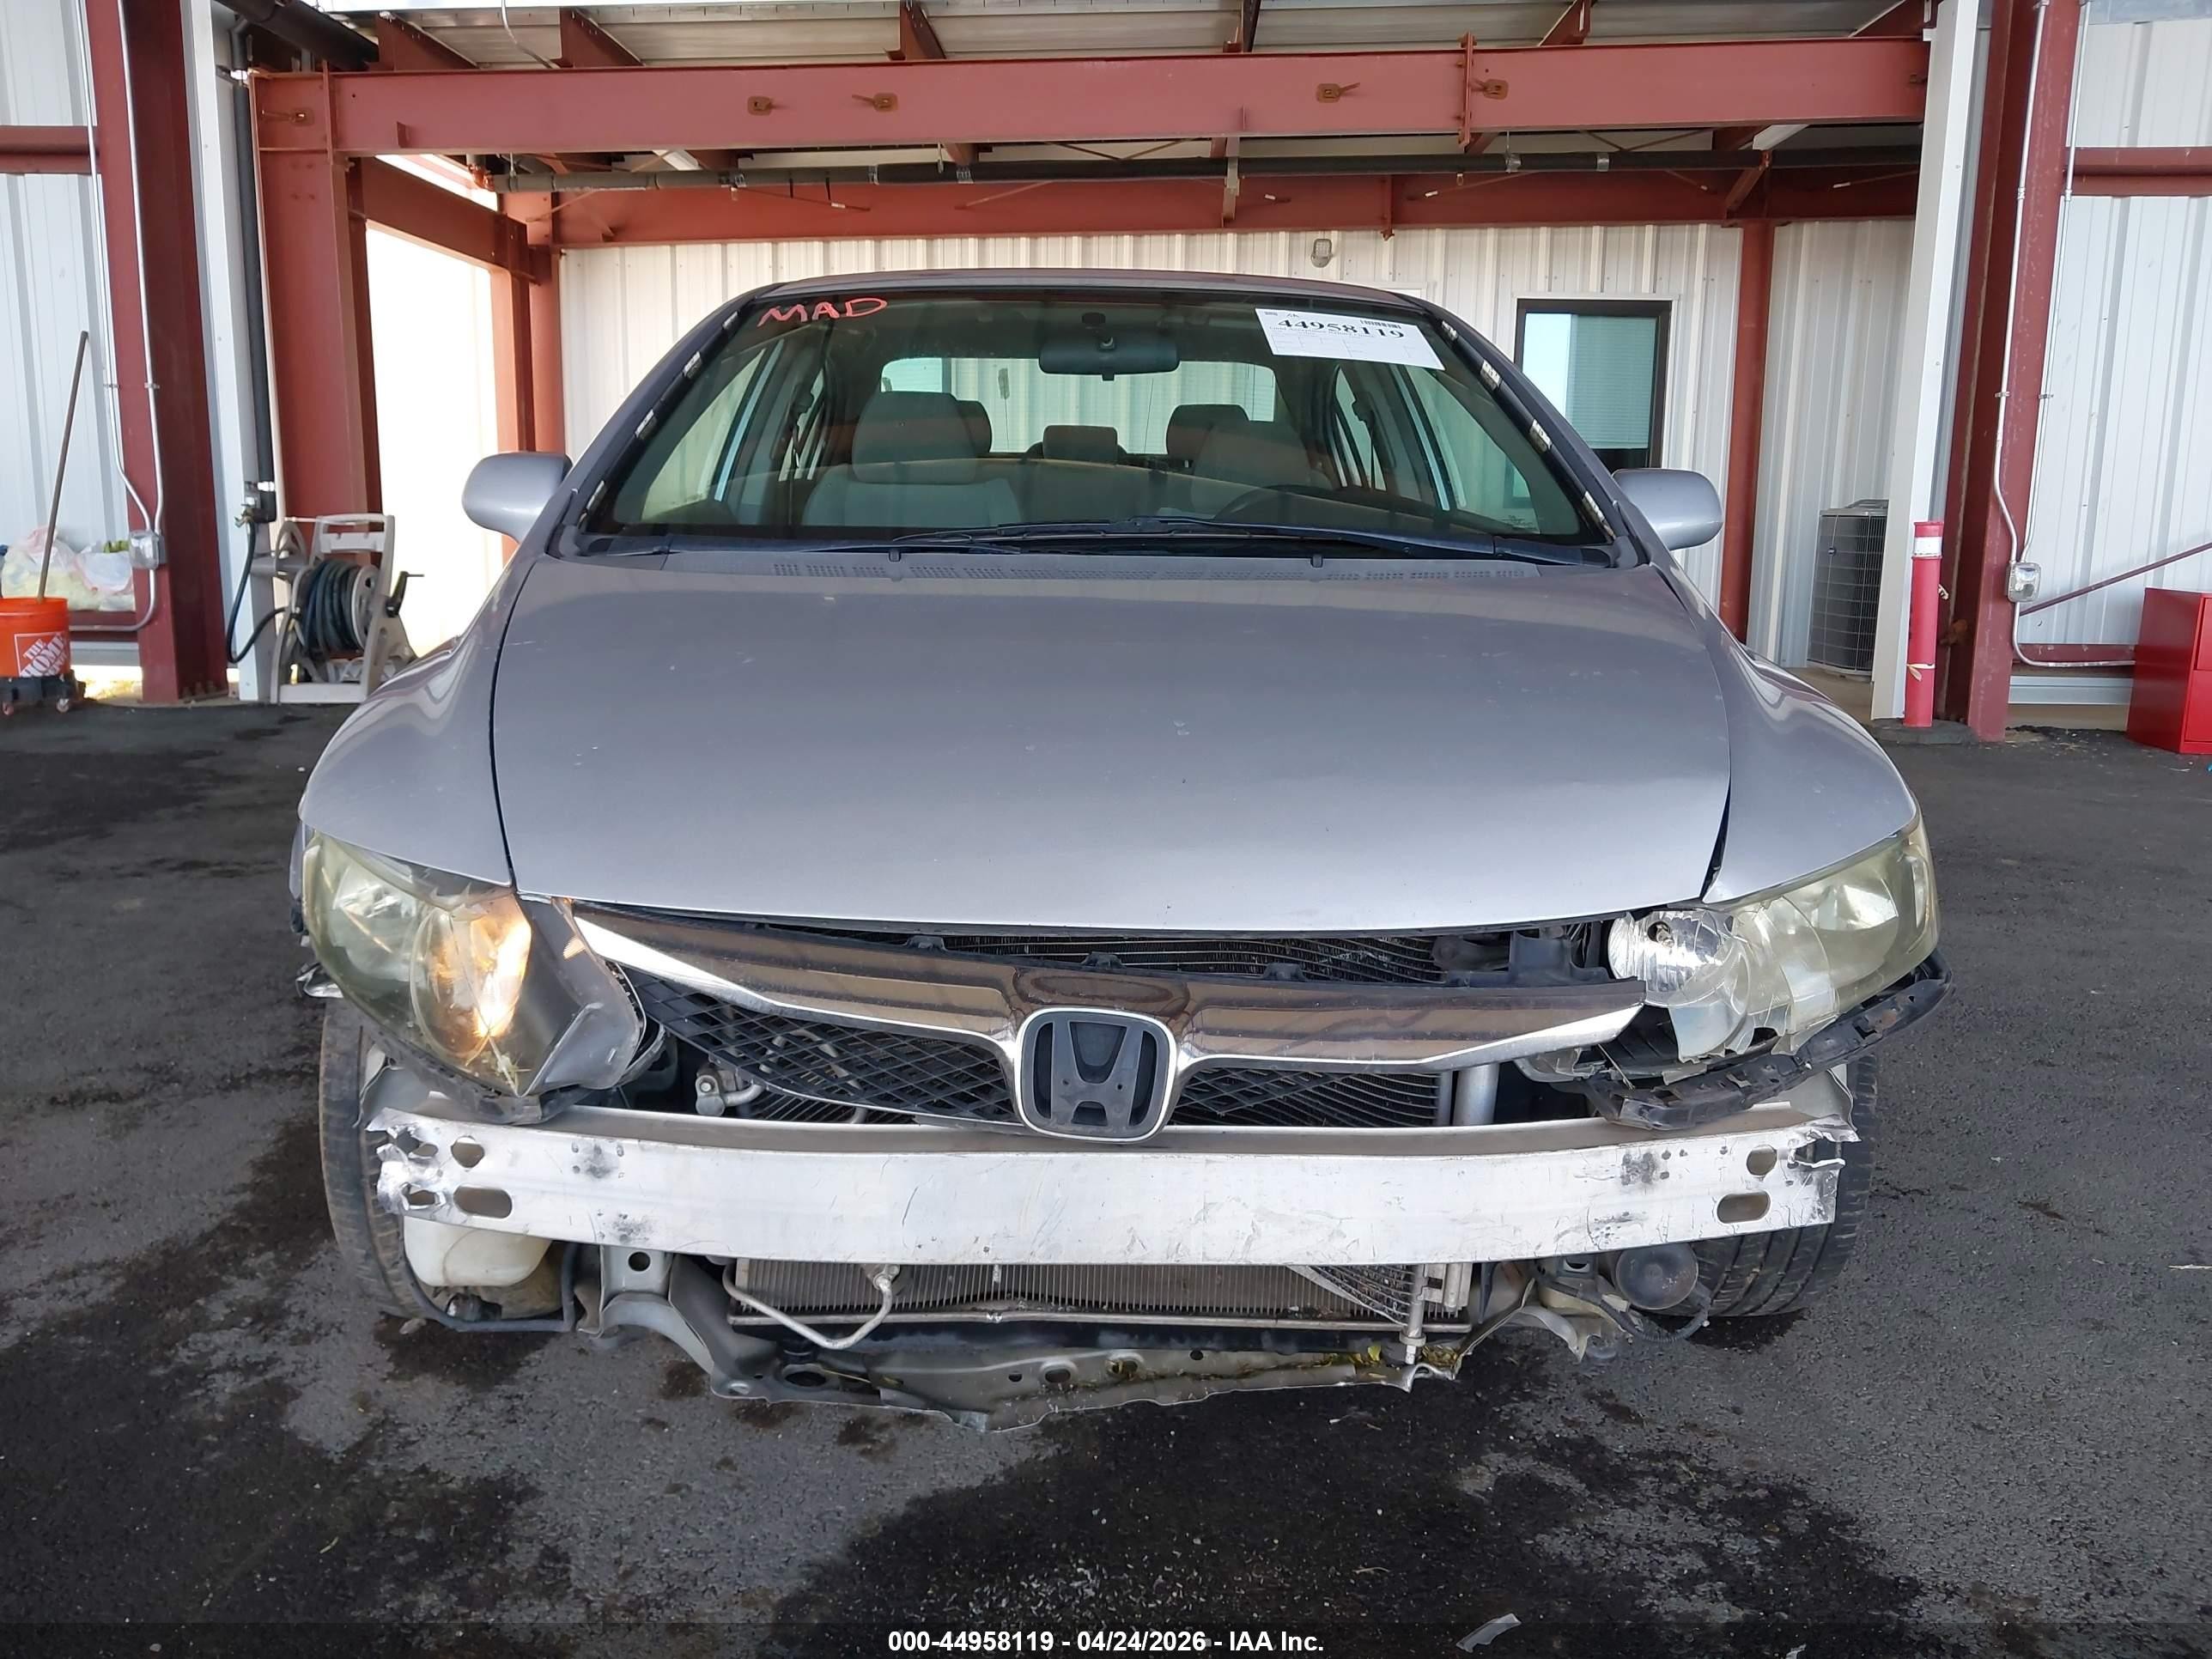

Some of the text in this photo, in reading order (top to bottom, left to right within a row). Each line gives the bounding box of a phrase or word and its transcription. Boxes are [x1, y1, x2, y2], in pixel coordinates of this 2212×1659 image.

[757, 297, 887, 327] MAD
[1278, 319, 1404, 338] 44958119
[19, 633, 66, 678] HOME
[23, 639, 46, 660] THE
